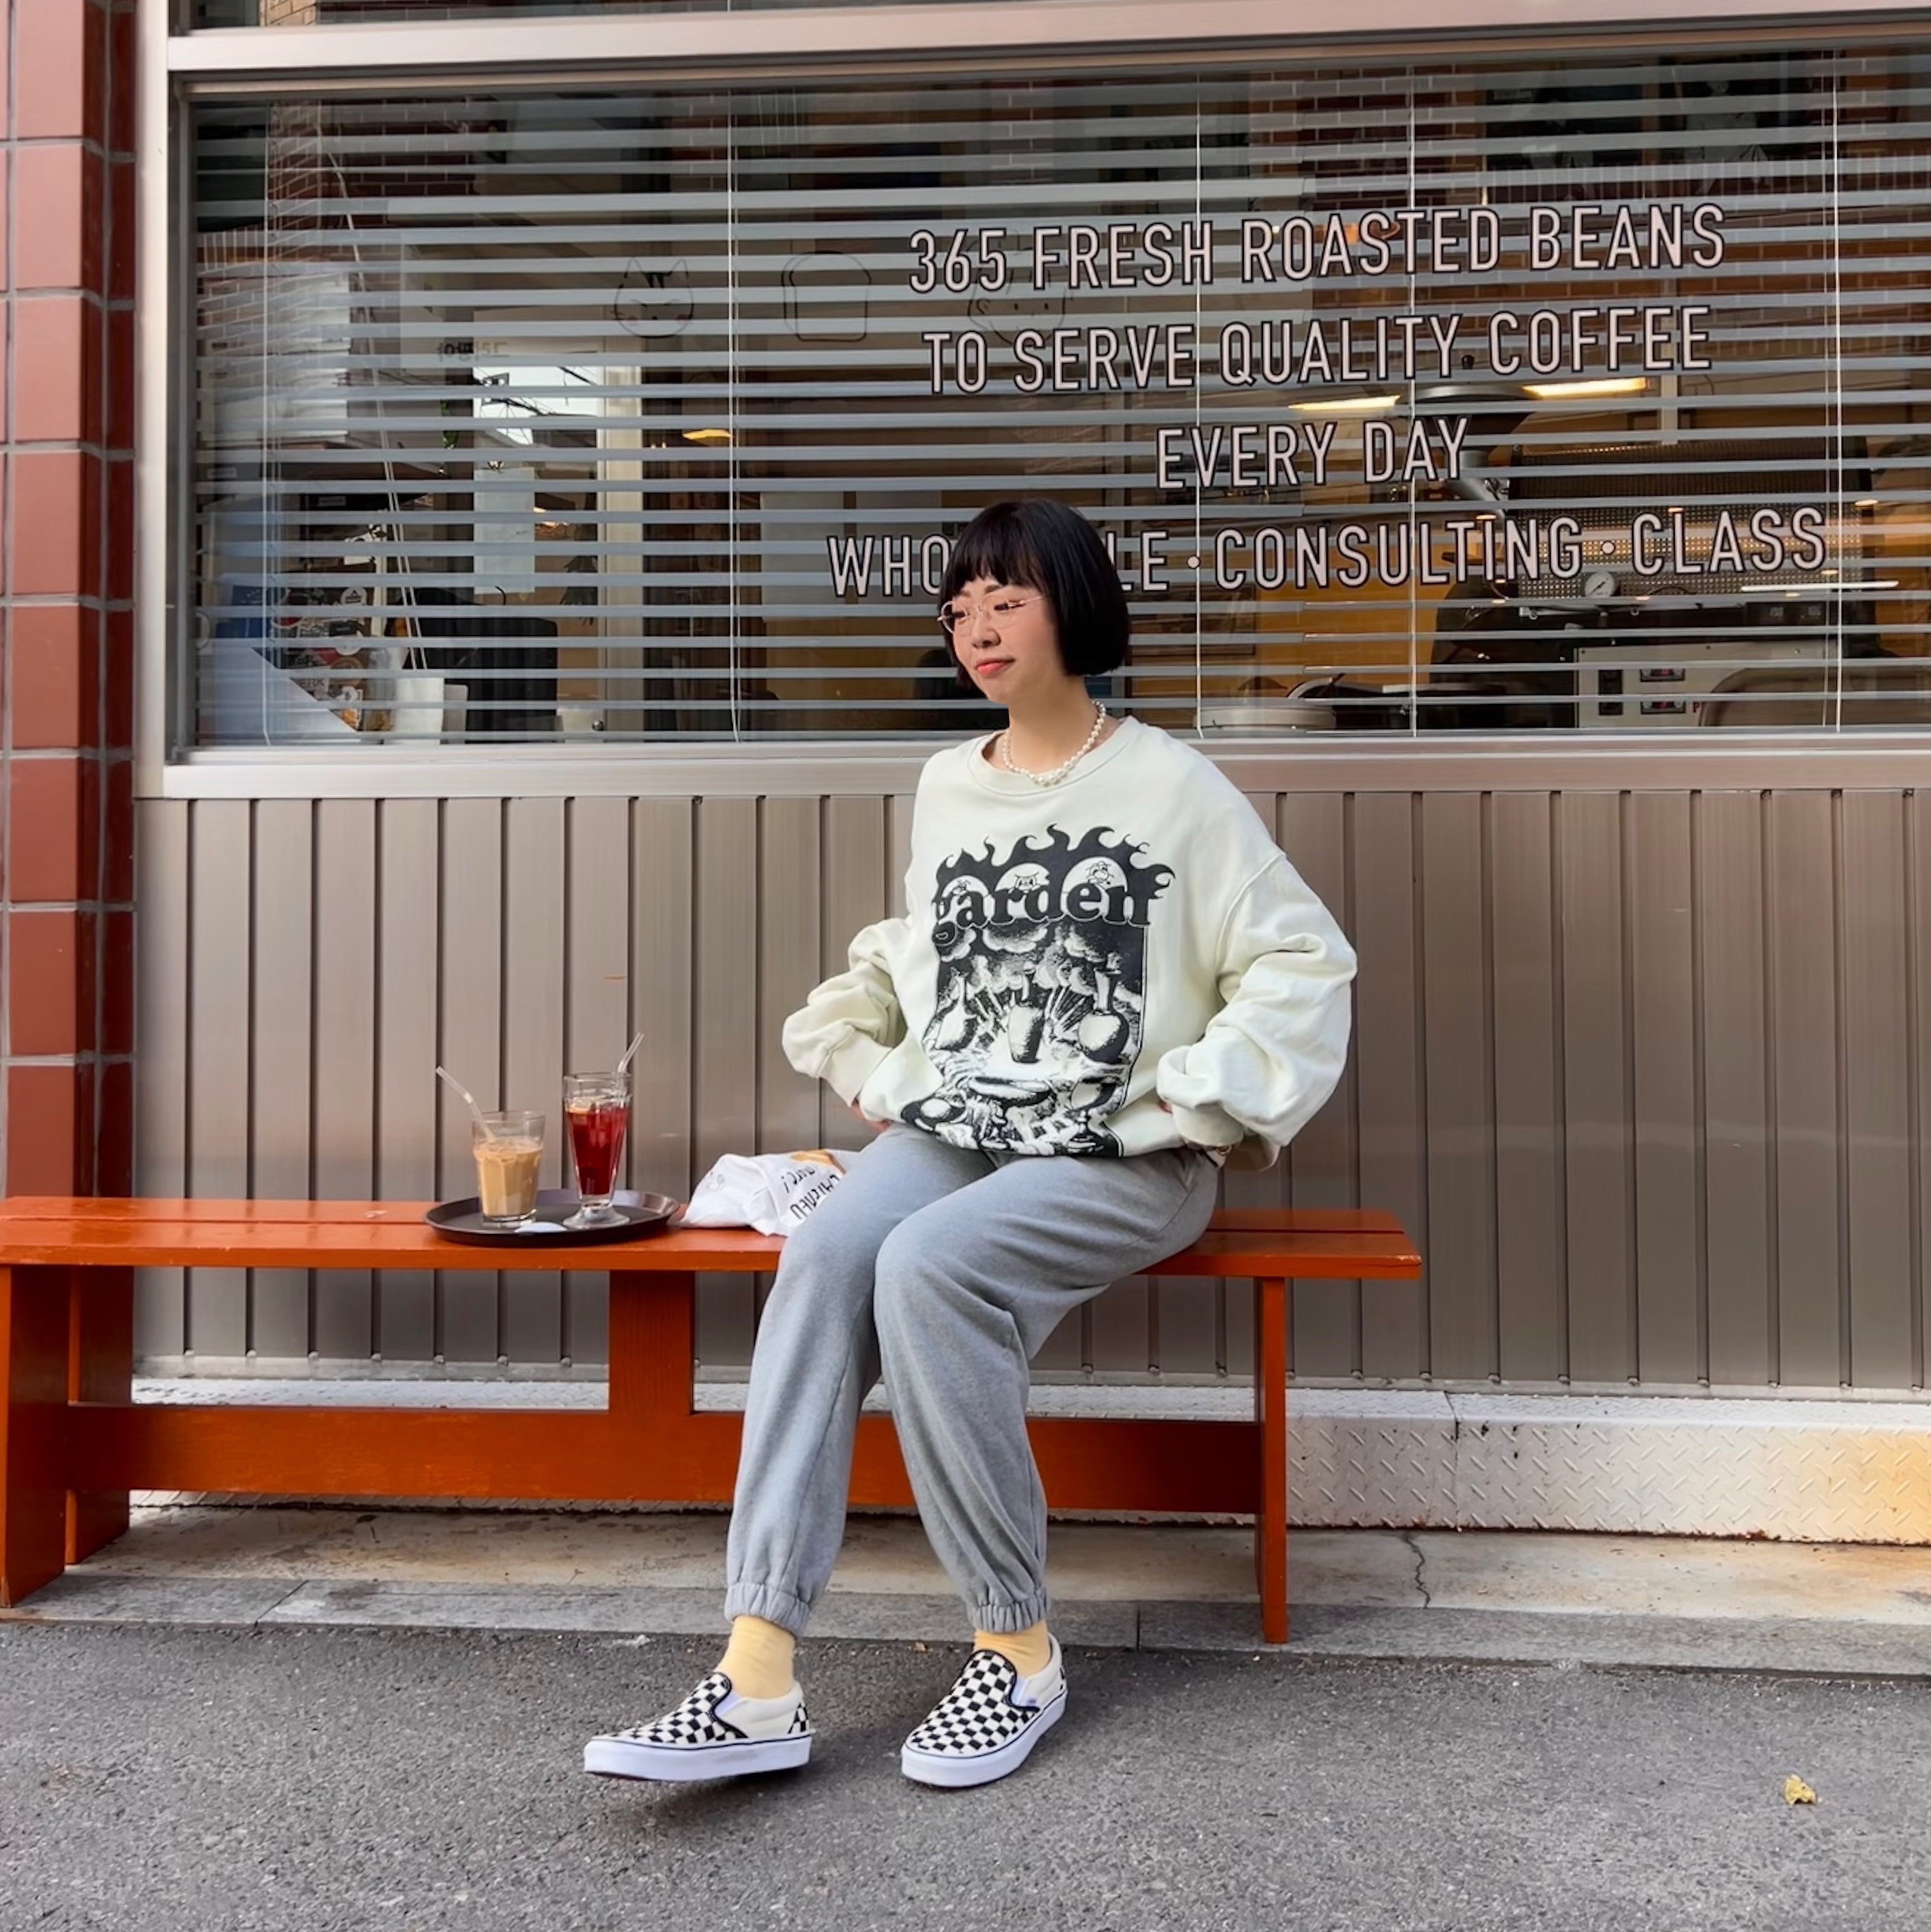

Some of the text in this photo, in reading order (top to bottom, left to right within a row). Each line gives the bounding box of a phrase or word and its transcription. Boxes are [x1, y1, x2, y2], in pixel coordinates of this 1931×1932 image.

[909, 202, 1727, 294] 365 FRESH ROASTED BEANS
[921, 305, 1713, 394] TO SERVE QUALITY COFFEE
[1156, 416, 1469, 489] EVERY DAY
[1215, 515, 1584, 590] CONSULTING
[1631, 506, 1827, 577] CLASS
